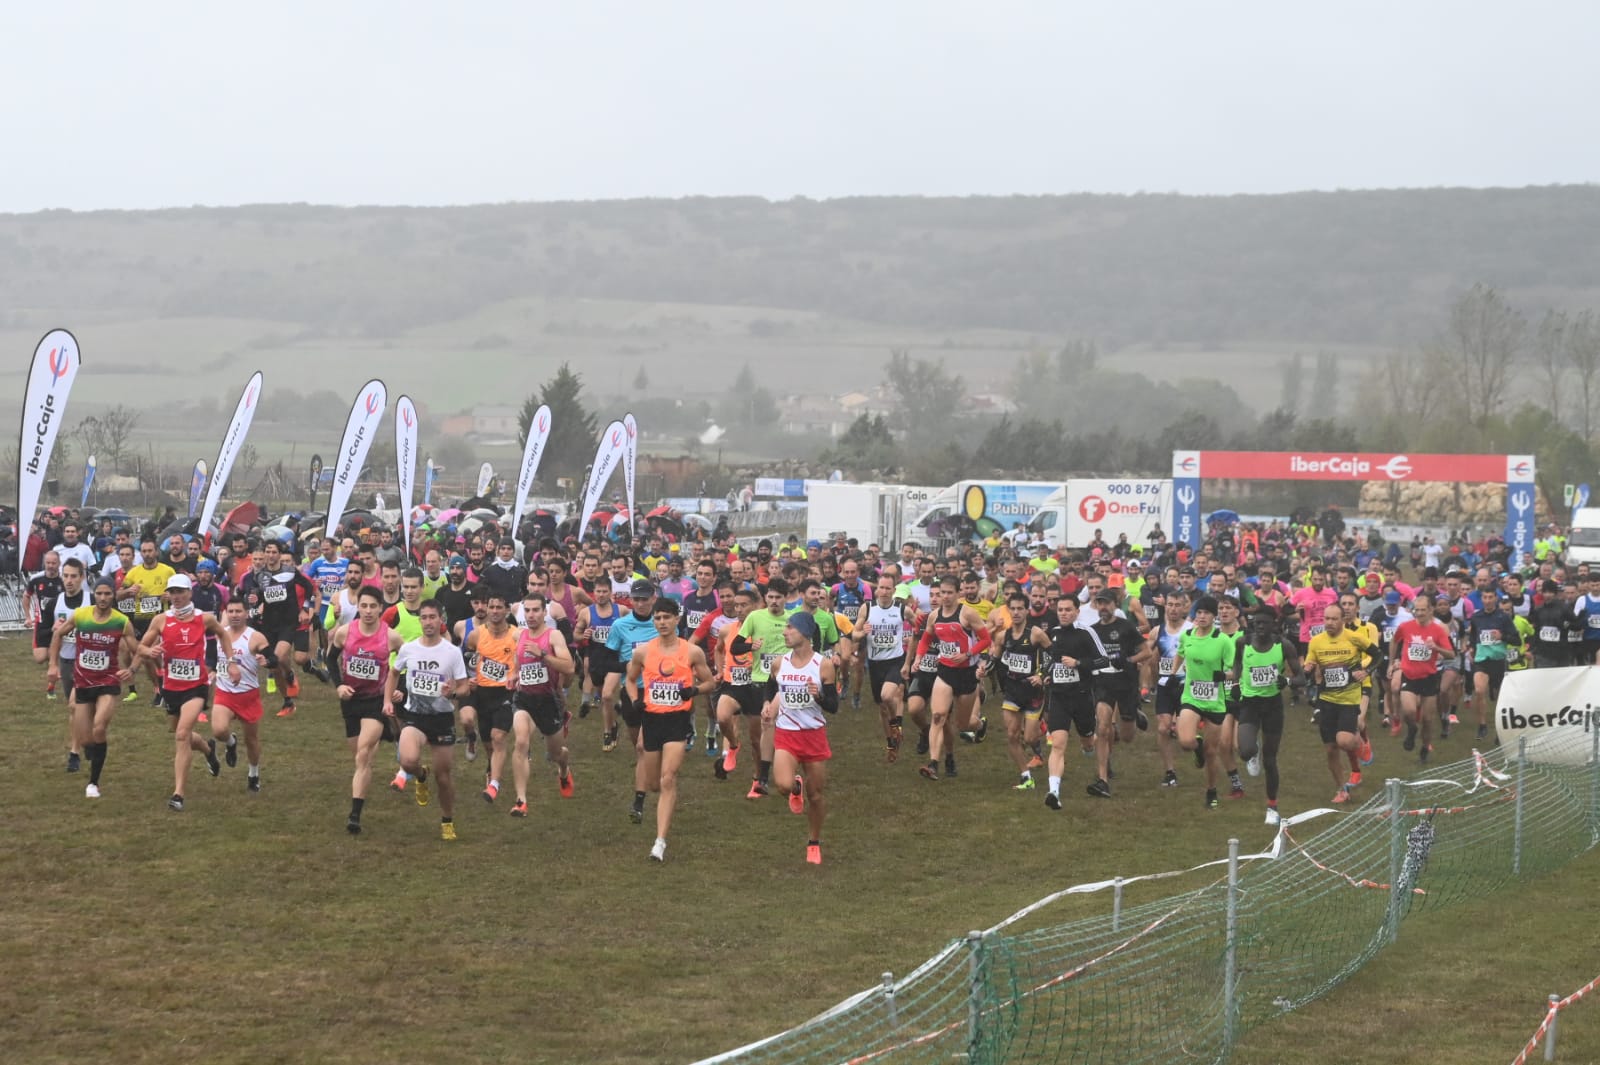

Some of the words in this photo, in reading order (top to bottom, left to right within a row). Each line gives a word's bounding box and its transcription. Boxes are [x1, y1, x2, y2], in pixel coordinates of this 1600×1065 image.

[26, 393, 55, 475] iberCaja
[337, 425, 365, 485] iberCaja
[1290, 455, 1370, 477] iberCaja
[1107, 484, 1131, 495] 900
[1135, 484, 1159, 495] 876
[906, 490, 928, 502] Caja
[1512, 520, 1527, 574] berCaja
[80, 631, 90, 640] La
[92, 632, 115, 644] Rioja
[873, 635, 894, 644] 6320
[82, 654, 106, 666] 6651
[1008, 659, 1028, 669] 6078
[171, 663, 196, 676] 6281
[349, 661, 376, 675] 6560
[482, 663, 505, 679] 6329
[1054, 669, 1075, 679] 6594
[520, 668, 544, 681] 6556
[781, 674, 813, 683] TREGA
[1252, 671, 1276, 682] 6073
[1325, 673, 1347, 683] 6083
[413, 678, 439, 692] 6351
[651, 689, 679, 701] 6410
[1192, 686, 1214, 697] 6001
[784, 692, 810, 704] 6380
